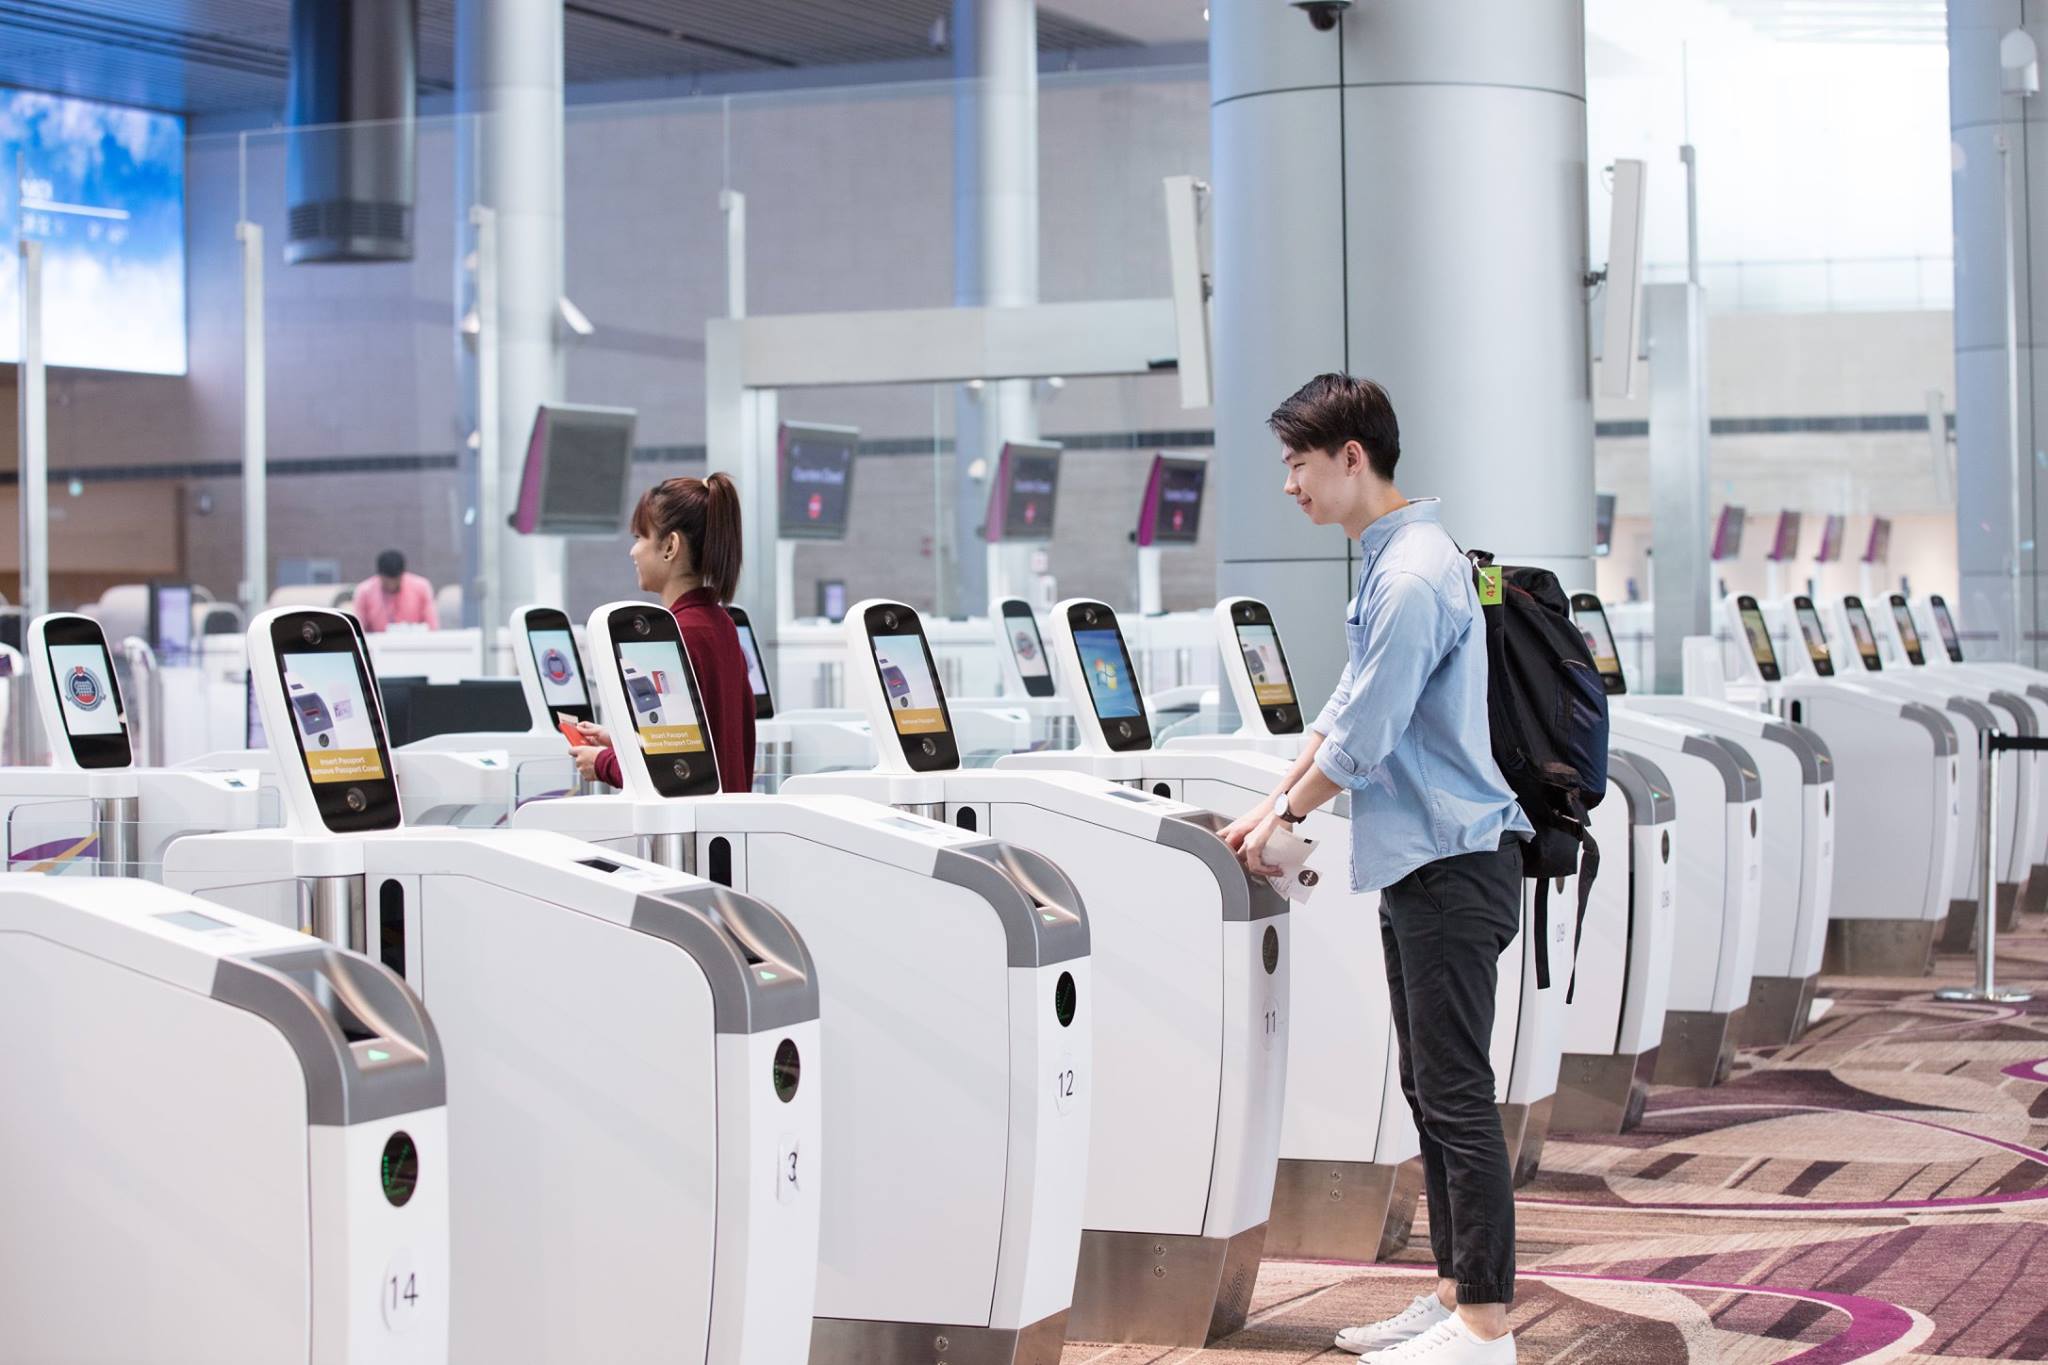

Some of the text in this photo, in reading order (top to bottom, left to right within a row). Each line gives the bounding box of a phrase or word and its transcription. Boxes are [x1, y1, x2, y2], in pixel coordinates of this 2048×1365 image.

[335, 765, 361, 775] Passport
[338, 756, 365, 766] Passport
[1264, 1010, 1276, 1034] 11
[1058, 1069, 1074, 1098] 12
[788, 1151, 798, 1182] 3
[390, 1271, 419, 1310] 14
